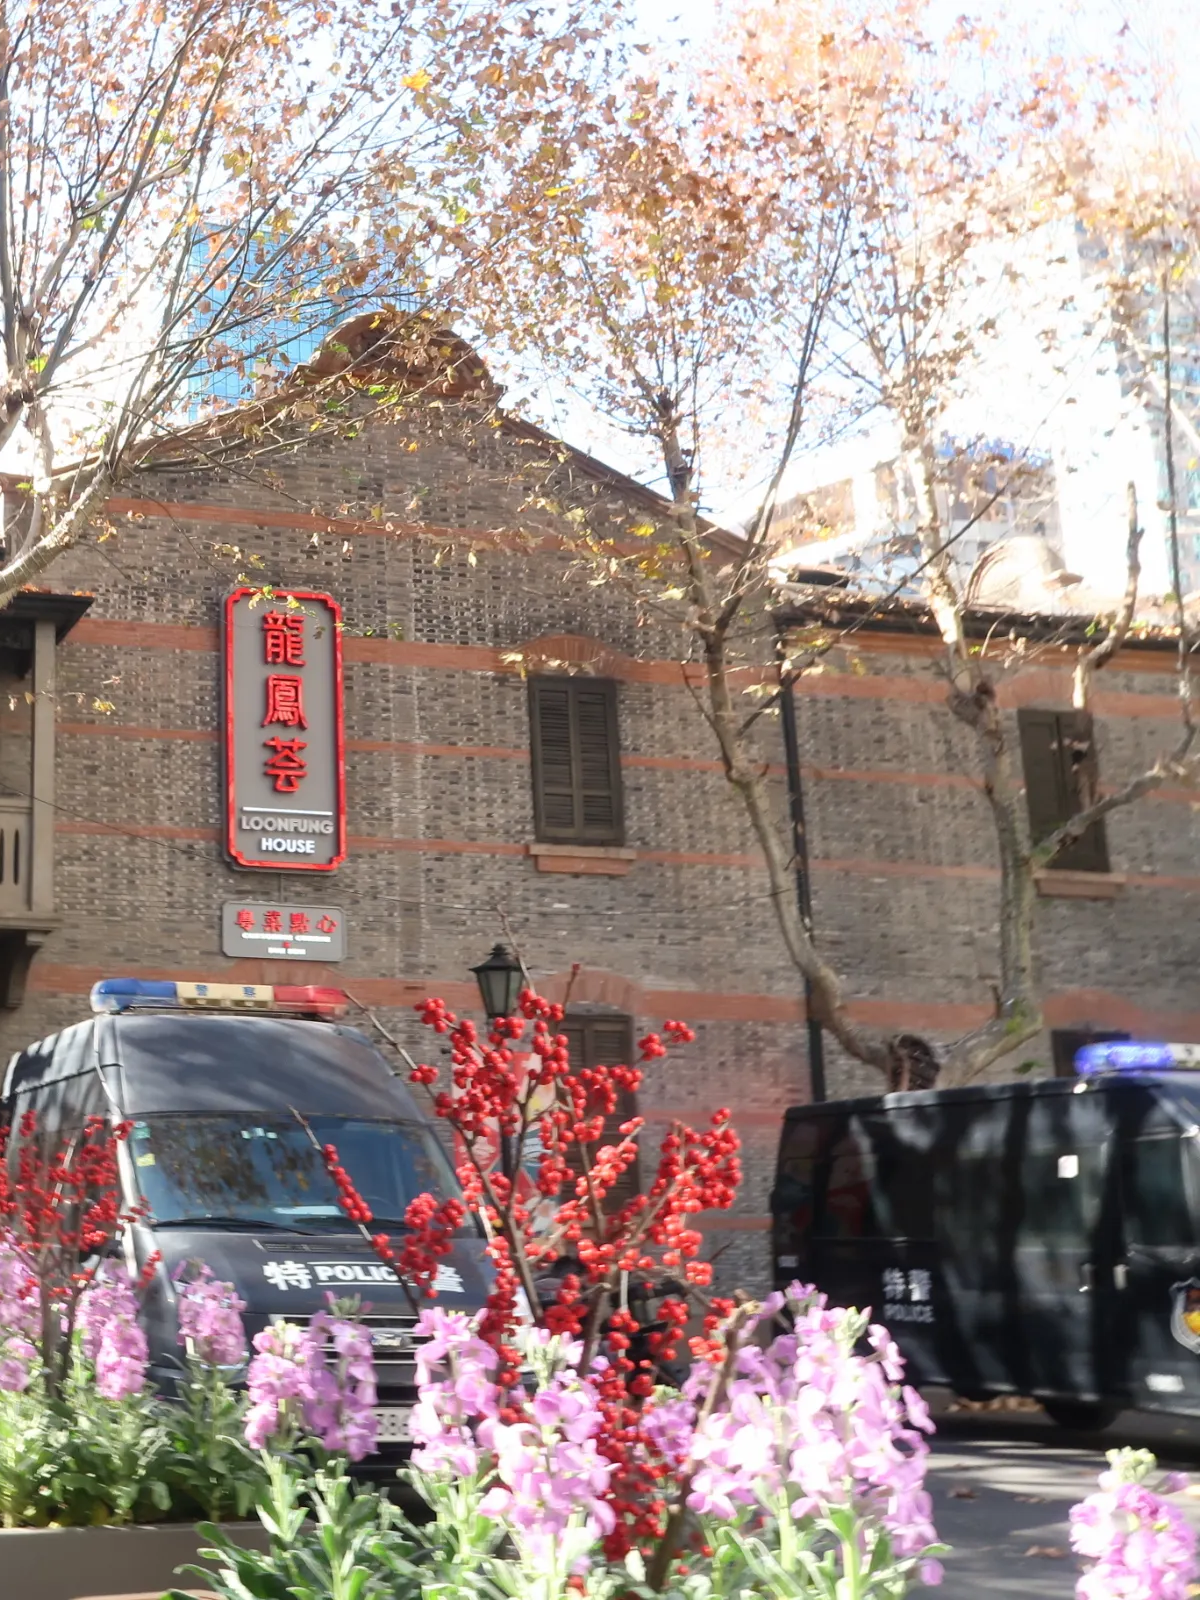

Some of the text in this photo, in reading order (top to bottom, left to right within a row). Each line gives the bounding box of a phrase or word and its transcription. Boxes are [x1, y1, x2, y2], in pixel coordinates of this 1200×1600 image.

[241, 815, 334, 835] LOONFUNG
[261, 837, 316, 854] HOUSE
[314, 1265, 412, 1283] POLIC
